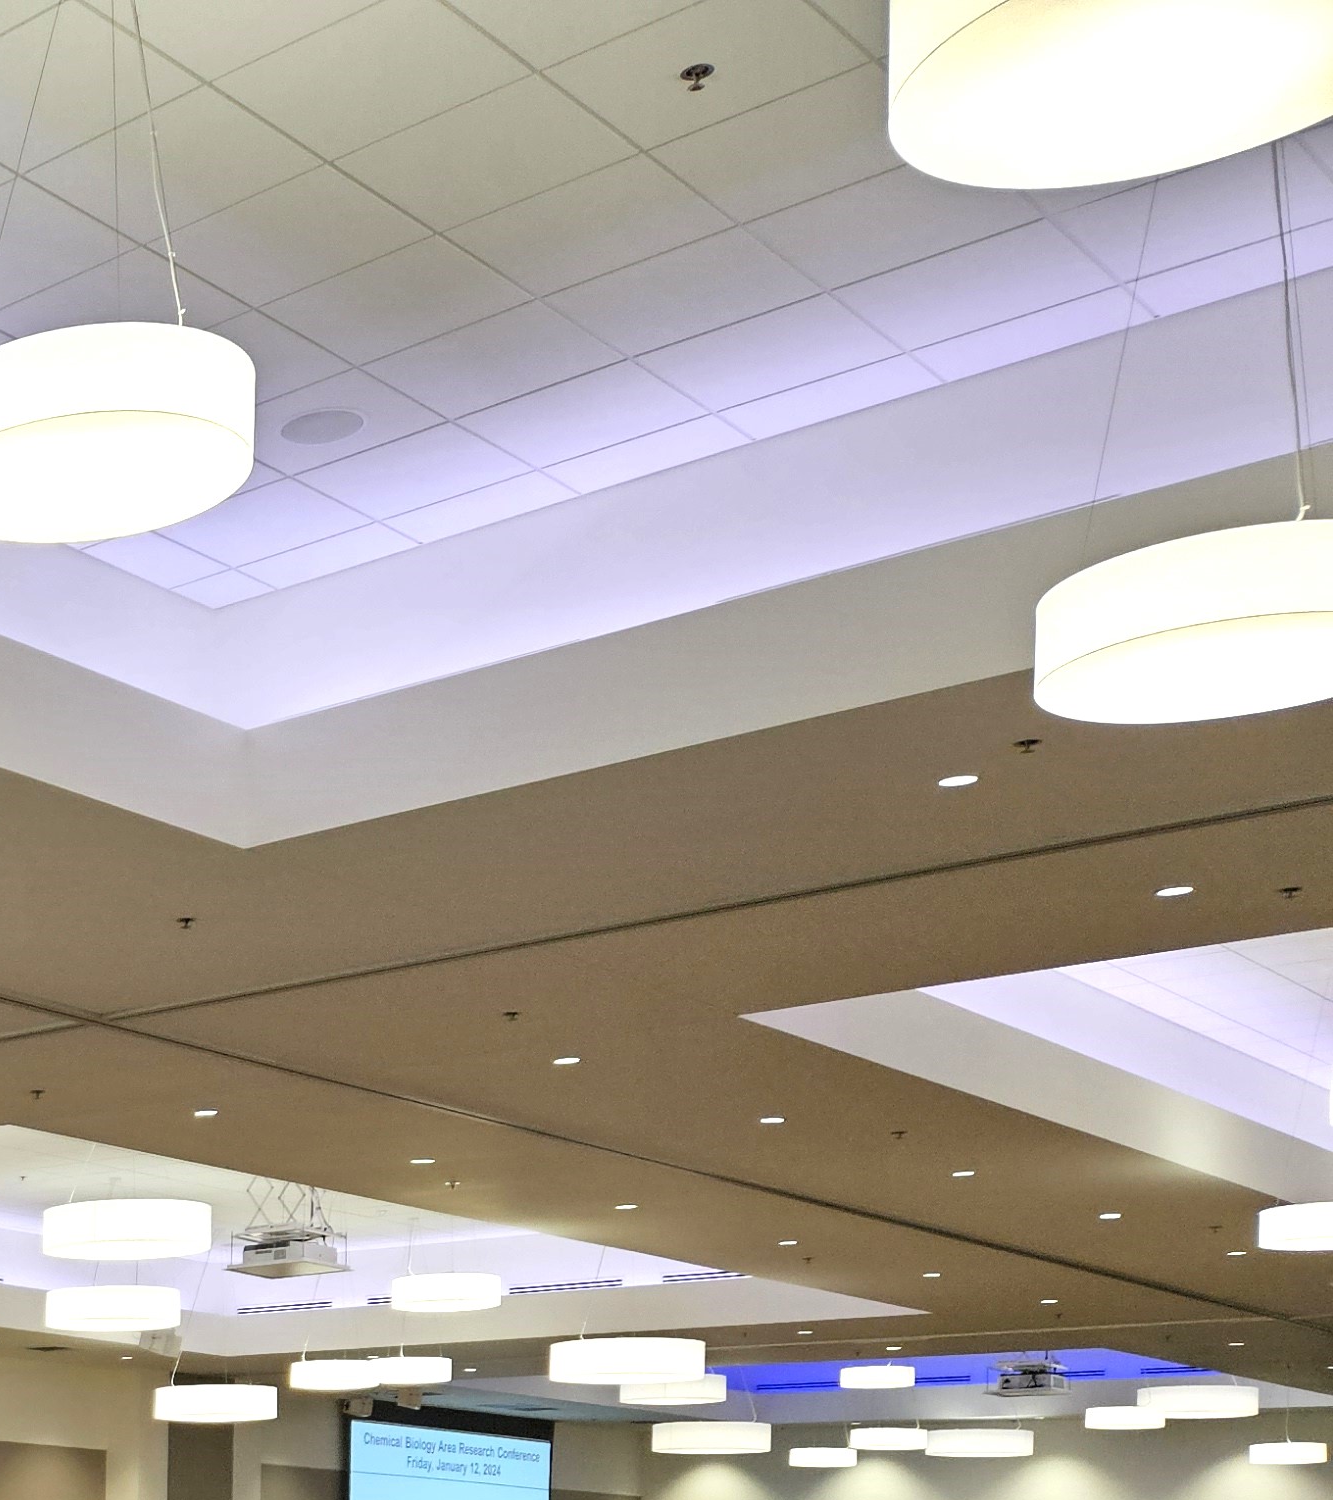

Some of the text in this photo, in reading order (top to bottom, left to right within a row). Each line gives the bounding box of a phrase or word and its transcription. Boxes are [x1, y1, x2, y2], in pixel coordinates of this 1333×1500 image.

[363, 1432, 541, 1463] Chemical Biology Area Research Conference
[436, 1459, 467, 1476] January
[483, 1463, 501, 1476] 2024
